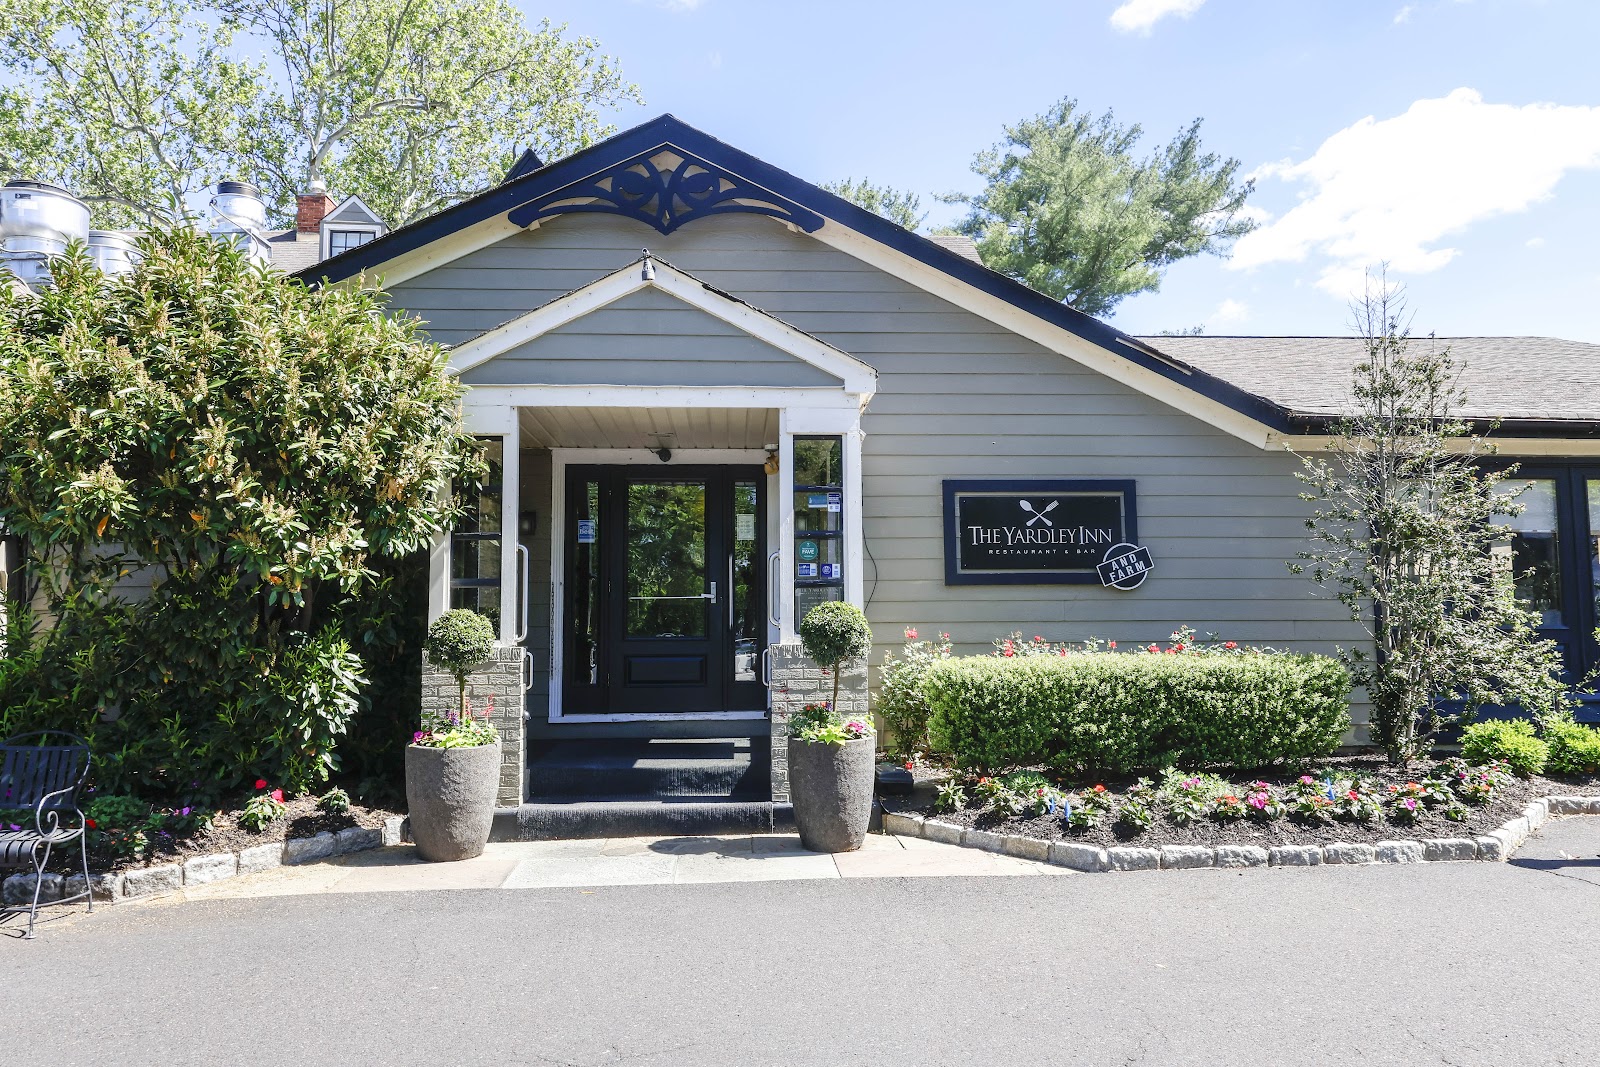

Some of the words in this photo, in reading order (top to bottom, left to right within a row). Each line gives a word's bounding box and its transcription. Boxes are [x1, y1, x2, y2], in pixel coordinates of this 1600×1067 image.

[967, 526, 1001, 545] THE
[1002, 526, 1077, 545] YARDLEY
[1079, 525, 1112, 545] INN
[1109, 560, 1146, 582] FARM
[1111, 553, 1138, 571] AND
